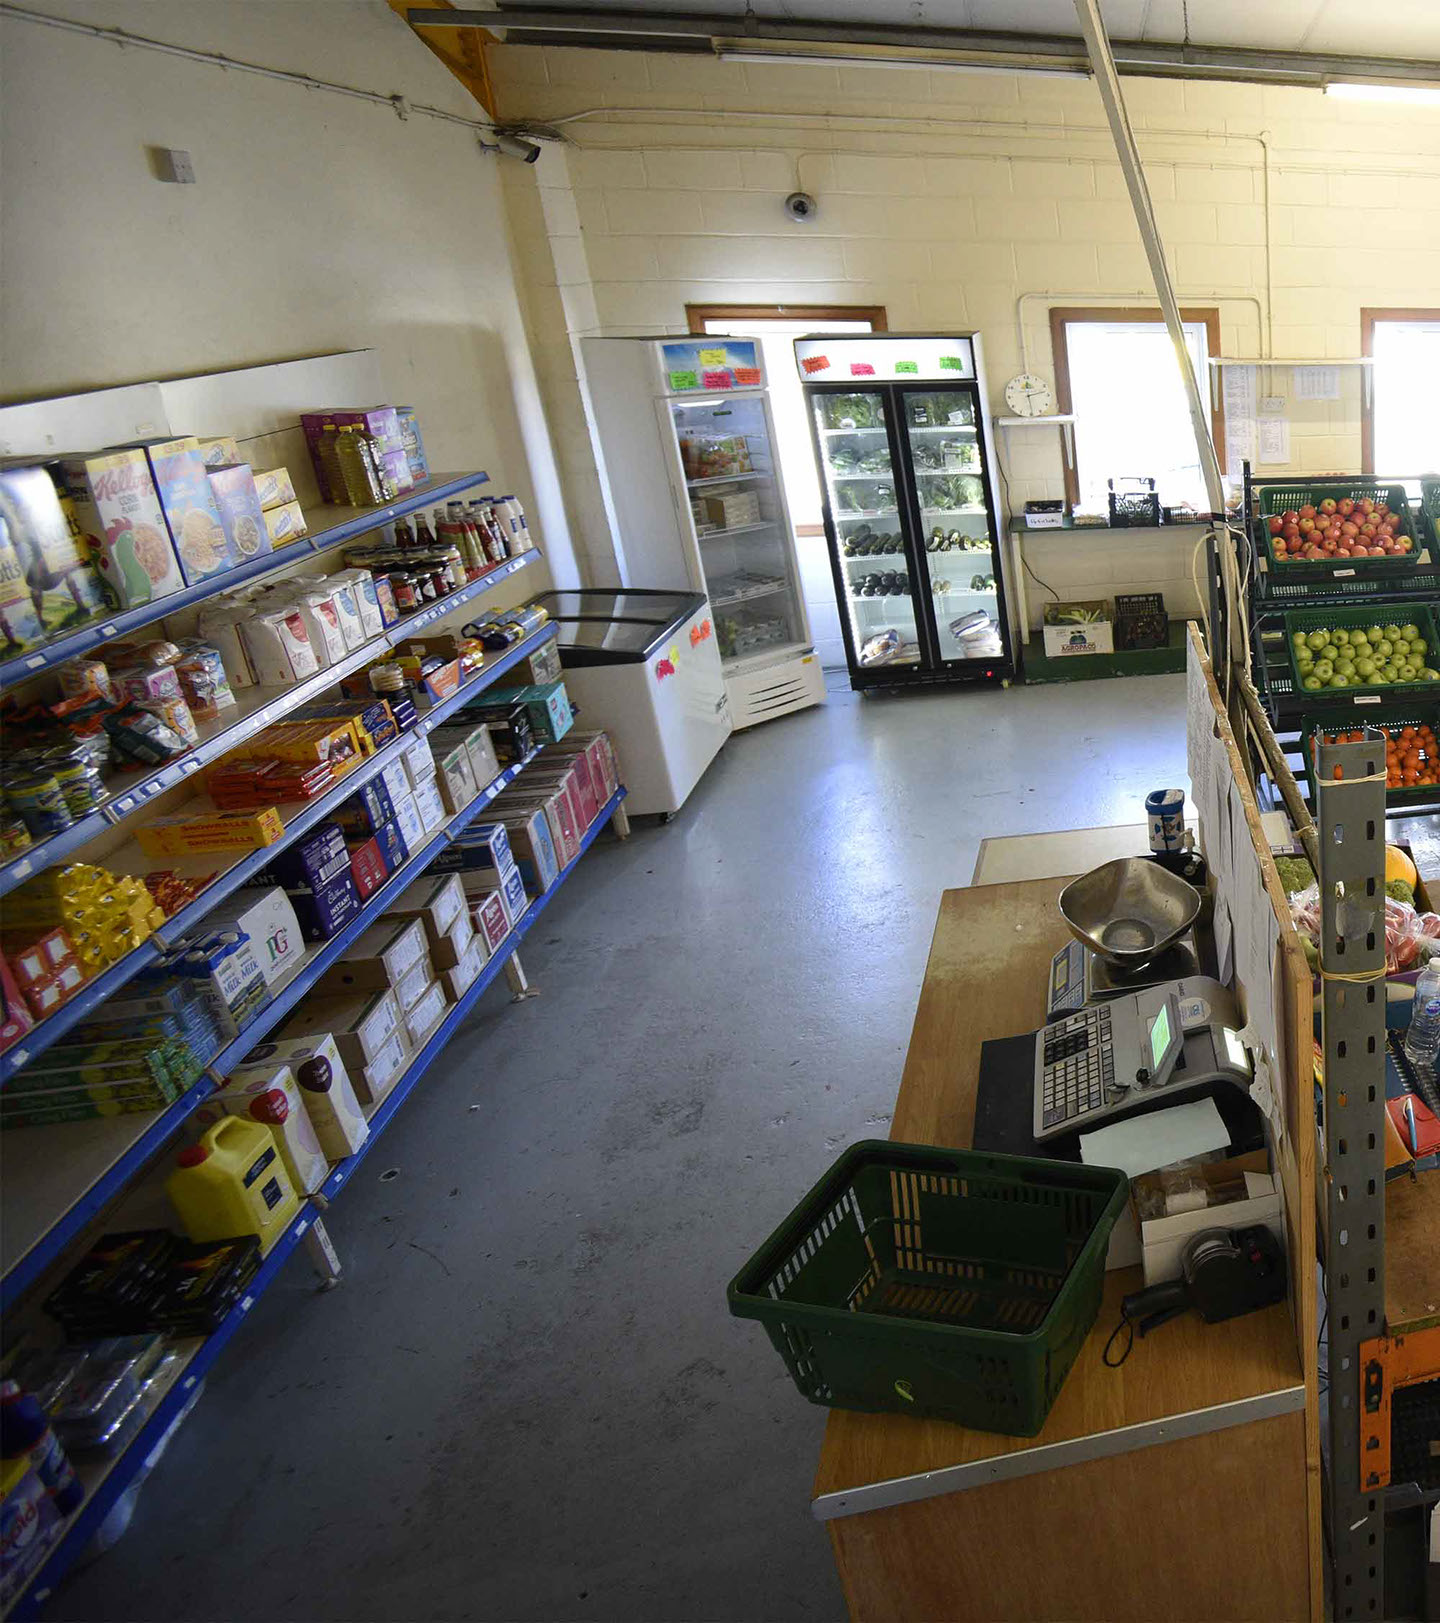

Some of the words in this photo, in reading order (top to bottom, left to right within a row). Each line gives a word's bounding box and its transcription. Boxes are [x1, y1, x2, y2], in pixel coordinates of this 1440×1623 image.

[330, 894, 351, 916] INSTANT
[265, 928, 289, 962] PG
[241, 960, 259, 980] Milk
[223, 977, 242, 997] Milk
